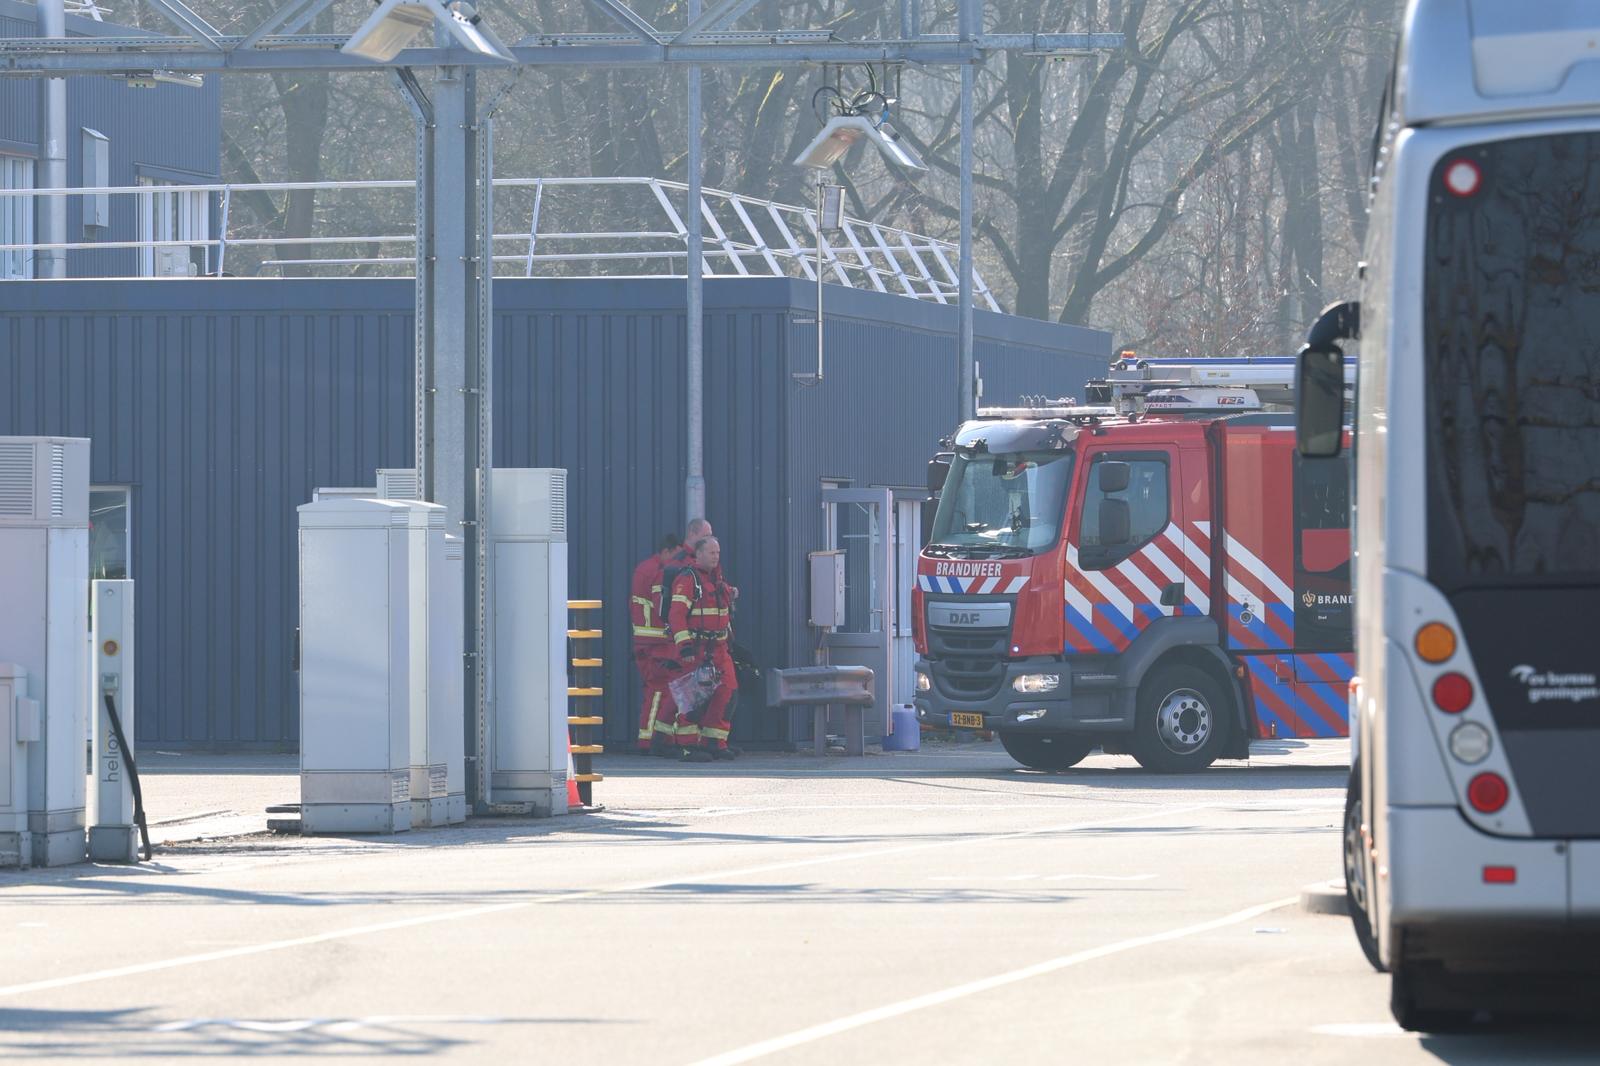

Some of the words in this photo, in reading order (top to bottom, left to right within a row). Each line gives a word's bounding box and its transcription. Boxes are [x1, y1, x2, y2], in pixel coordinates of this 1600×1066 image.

[936, 562, 1002, 577] BRANDWEER
[949, 612, 980, 624] DAF
[1528, 674, 1546, 686] ov
[1547, 671, 1596, 685] bureau
[1528, 686, 1597, 703] groningen
[102, 729, 119, 783] heliox
